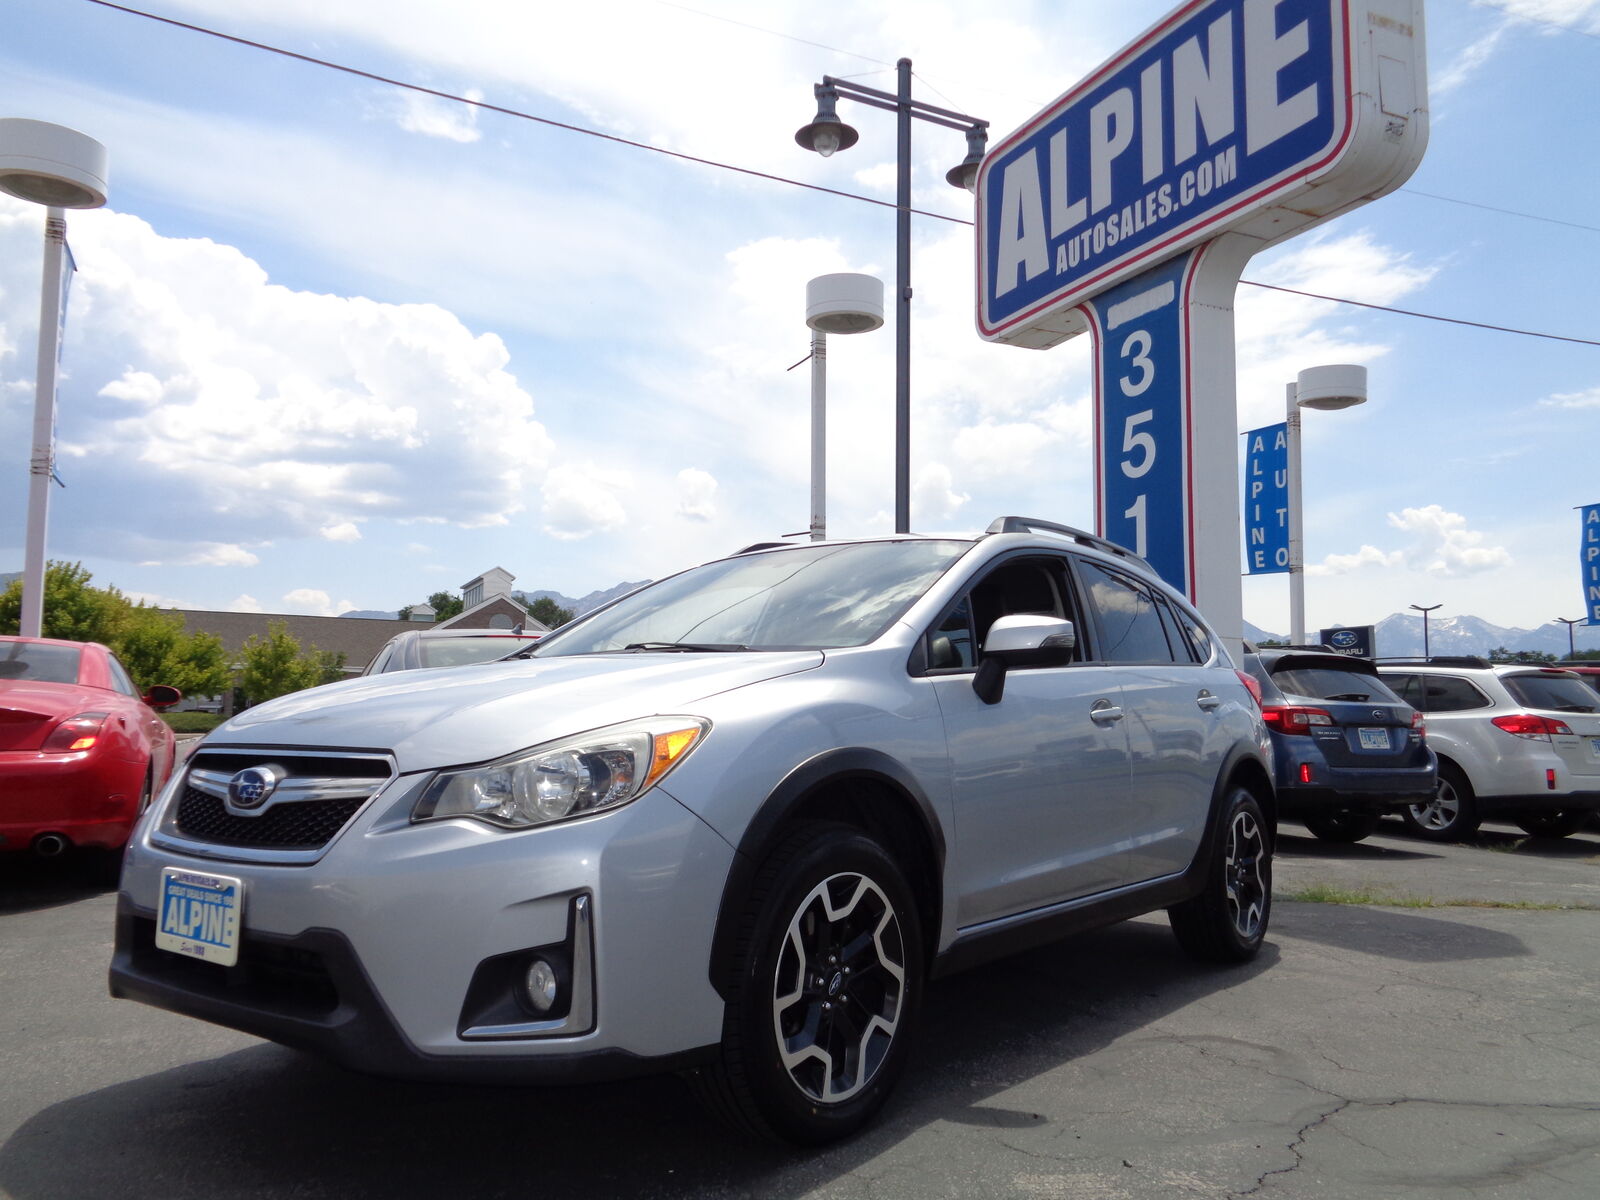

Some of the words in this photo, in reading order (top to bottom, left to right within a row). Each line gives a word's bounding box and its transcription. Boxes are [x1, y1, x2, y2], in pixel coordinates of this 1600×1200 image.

[996, 0, 1318, 299] ALPINE
[1055, 145, 1237, 276] AUTOSALES.COM
[1251, 435, 1265, 569] ALPINE
[1274, 430, 1289, 567] AUTO
[164, 896, 234, 947] ALPINE
